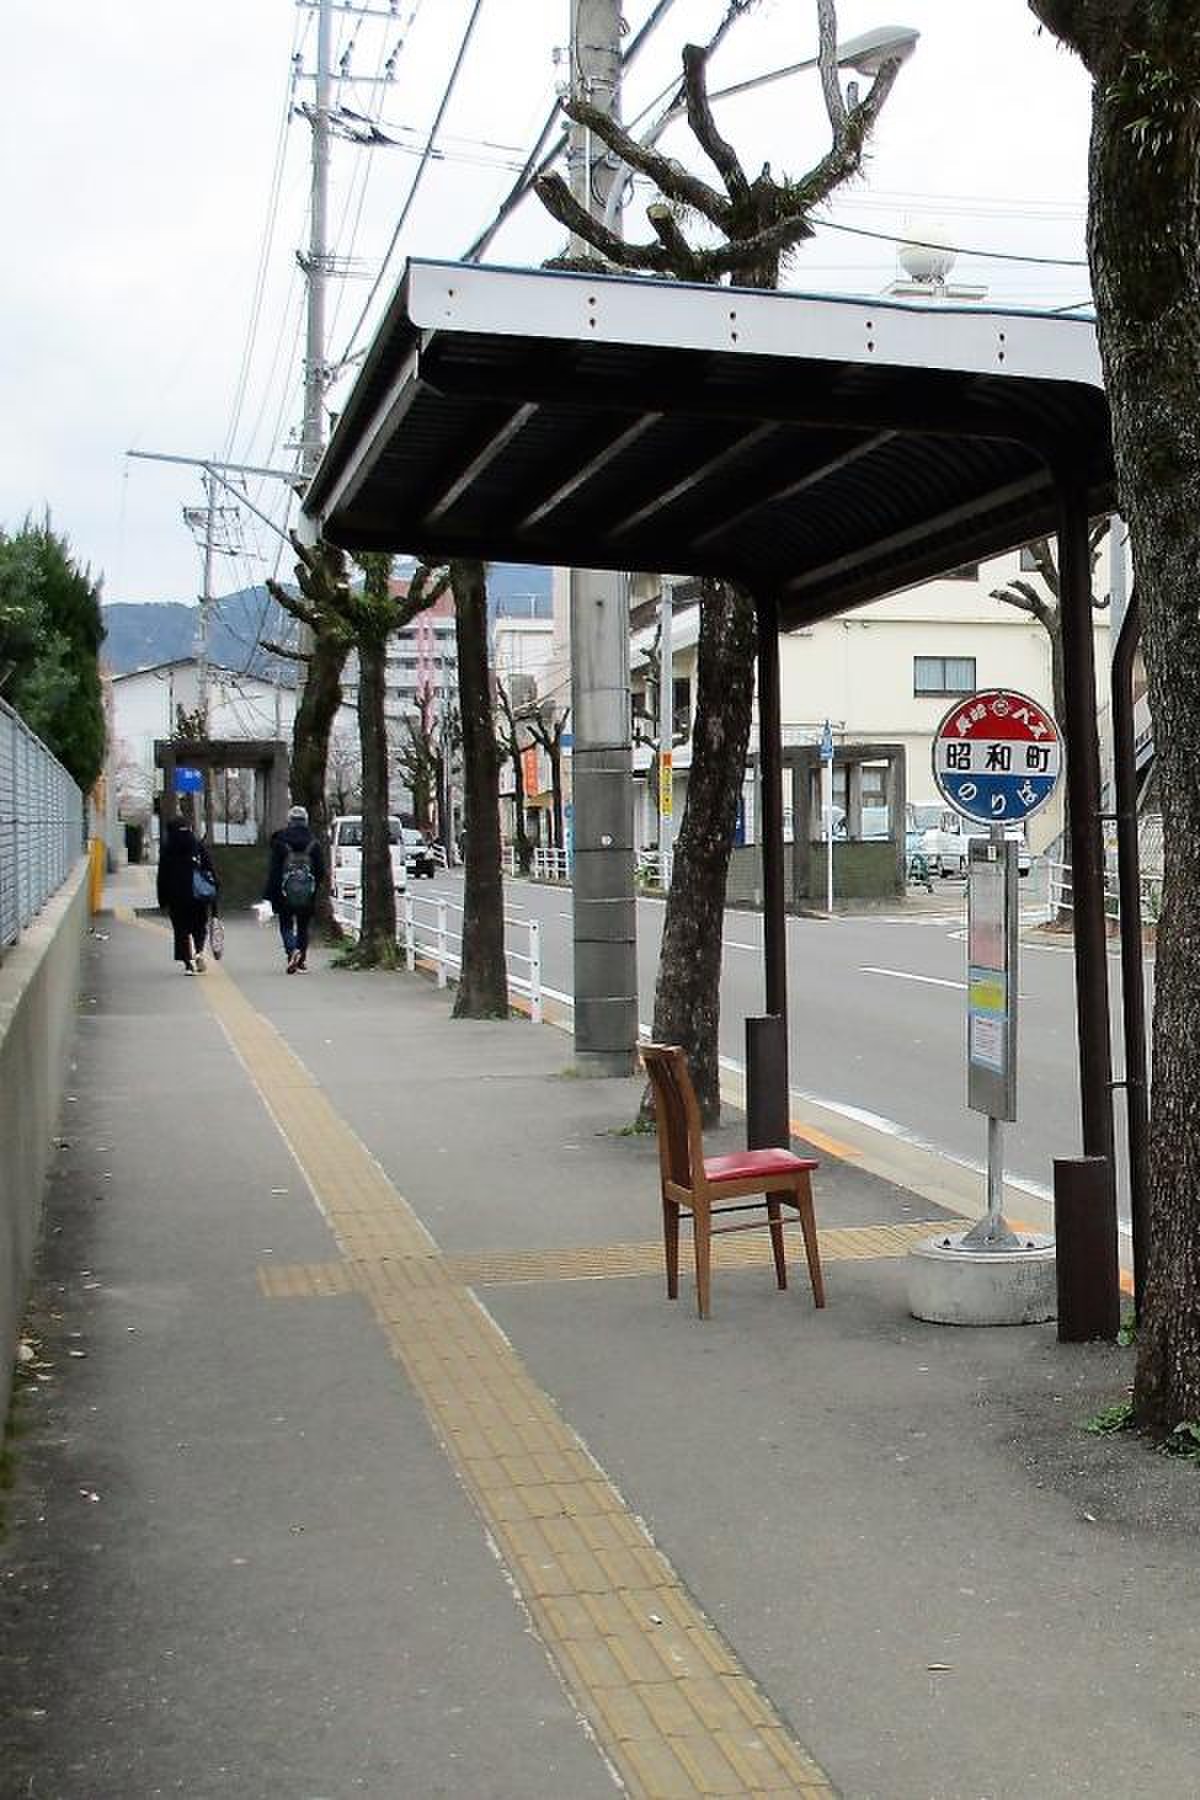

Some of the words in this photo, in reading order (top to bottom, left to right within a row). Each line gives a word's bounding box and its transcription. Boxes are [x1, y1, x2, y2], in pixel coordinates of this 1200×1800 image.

[947, 742, 1051, 773] 昭和町
[957, 780, 1038, 815] のりば
